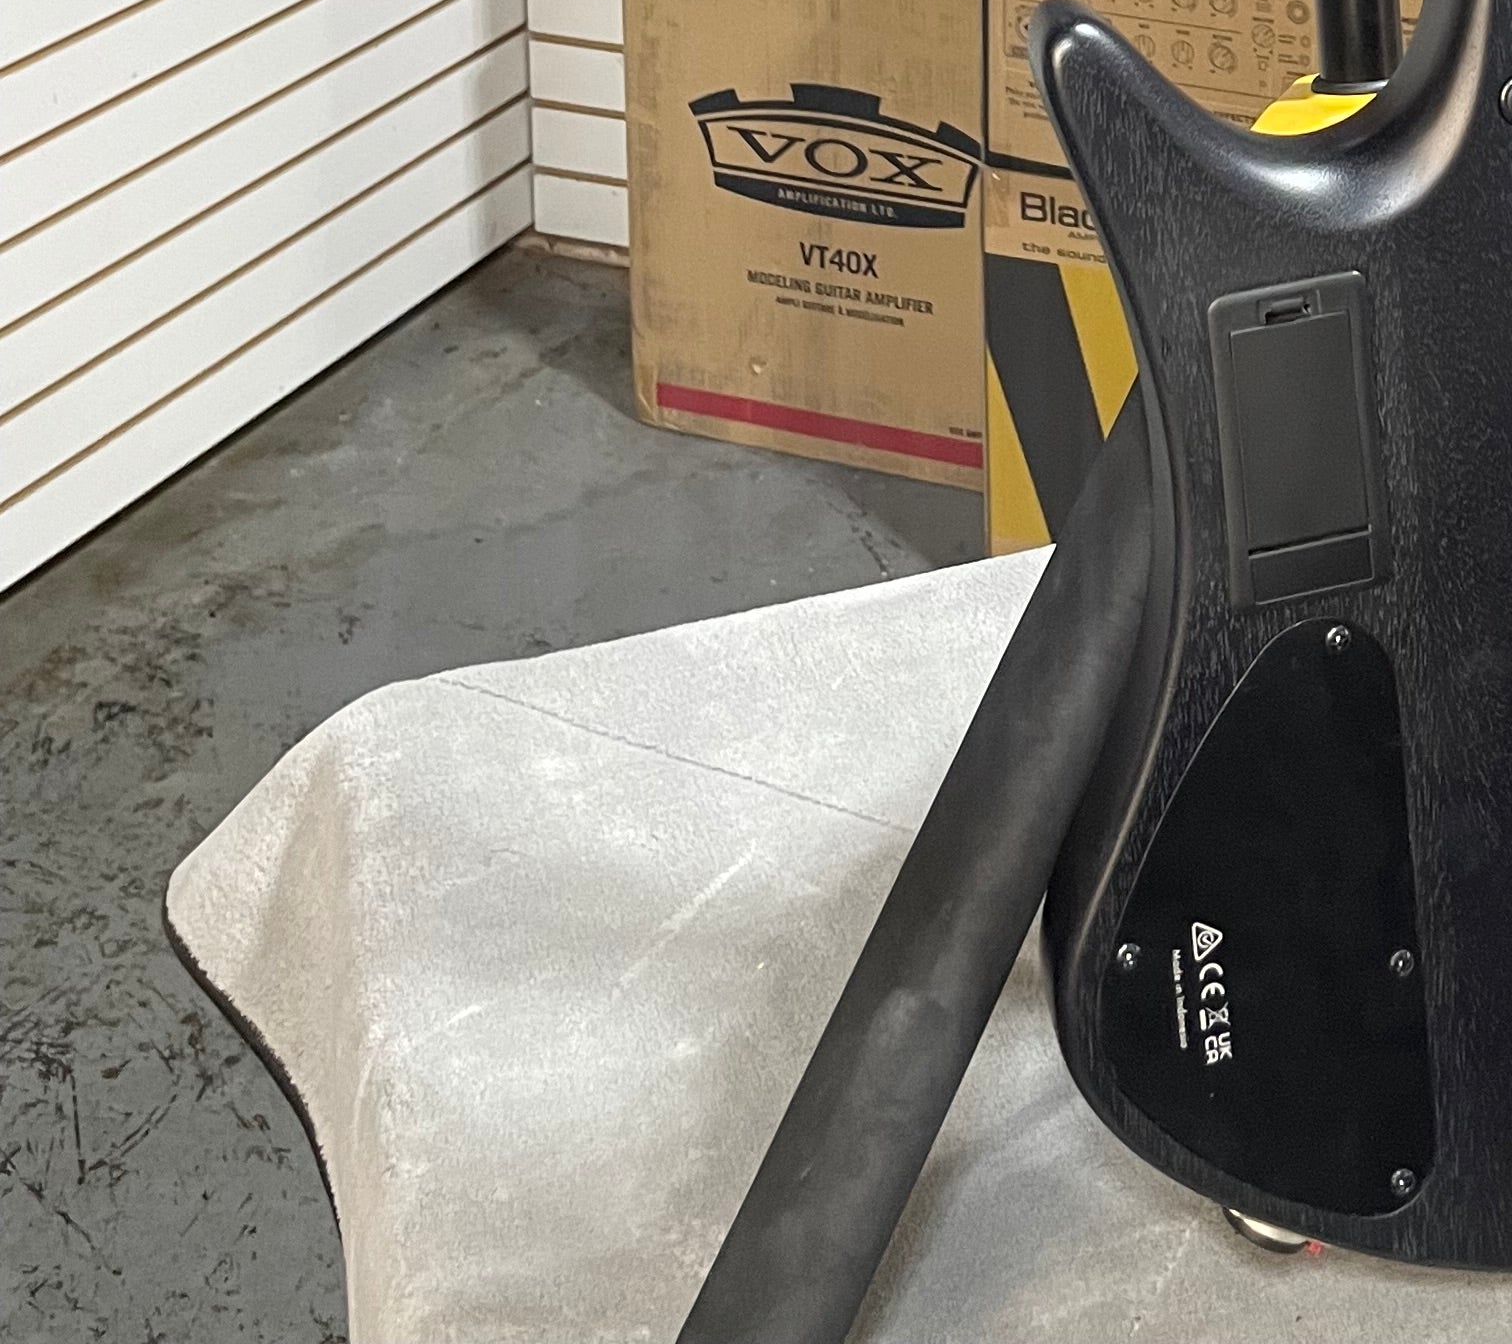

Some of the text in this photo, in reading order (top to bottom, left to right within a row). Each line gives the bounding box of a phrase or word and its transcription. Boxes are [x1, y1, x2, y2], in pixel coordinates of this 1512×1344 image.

[726, 125, 943, 193] VOX
[778, 187, 898, 219] AMPLIFICATION LTD.
[799, 241, 879, 279] VT40X
[1021, 241, 1051, 256] the
[747, 269, 934, 316] MODELING GUITAR AMPLIFIER
